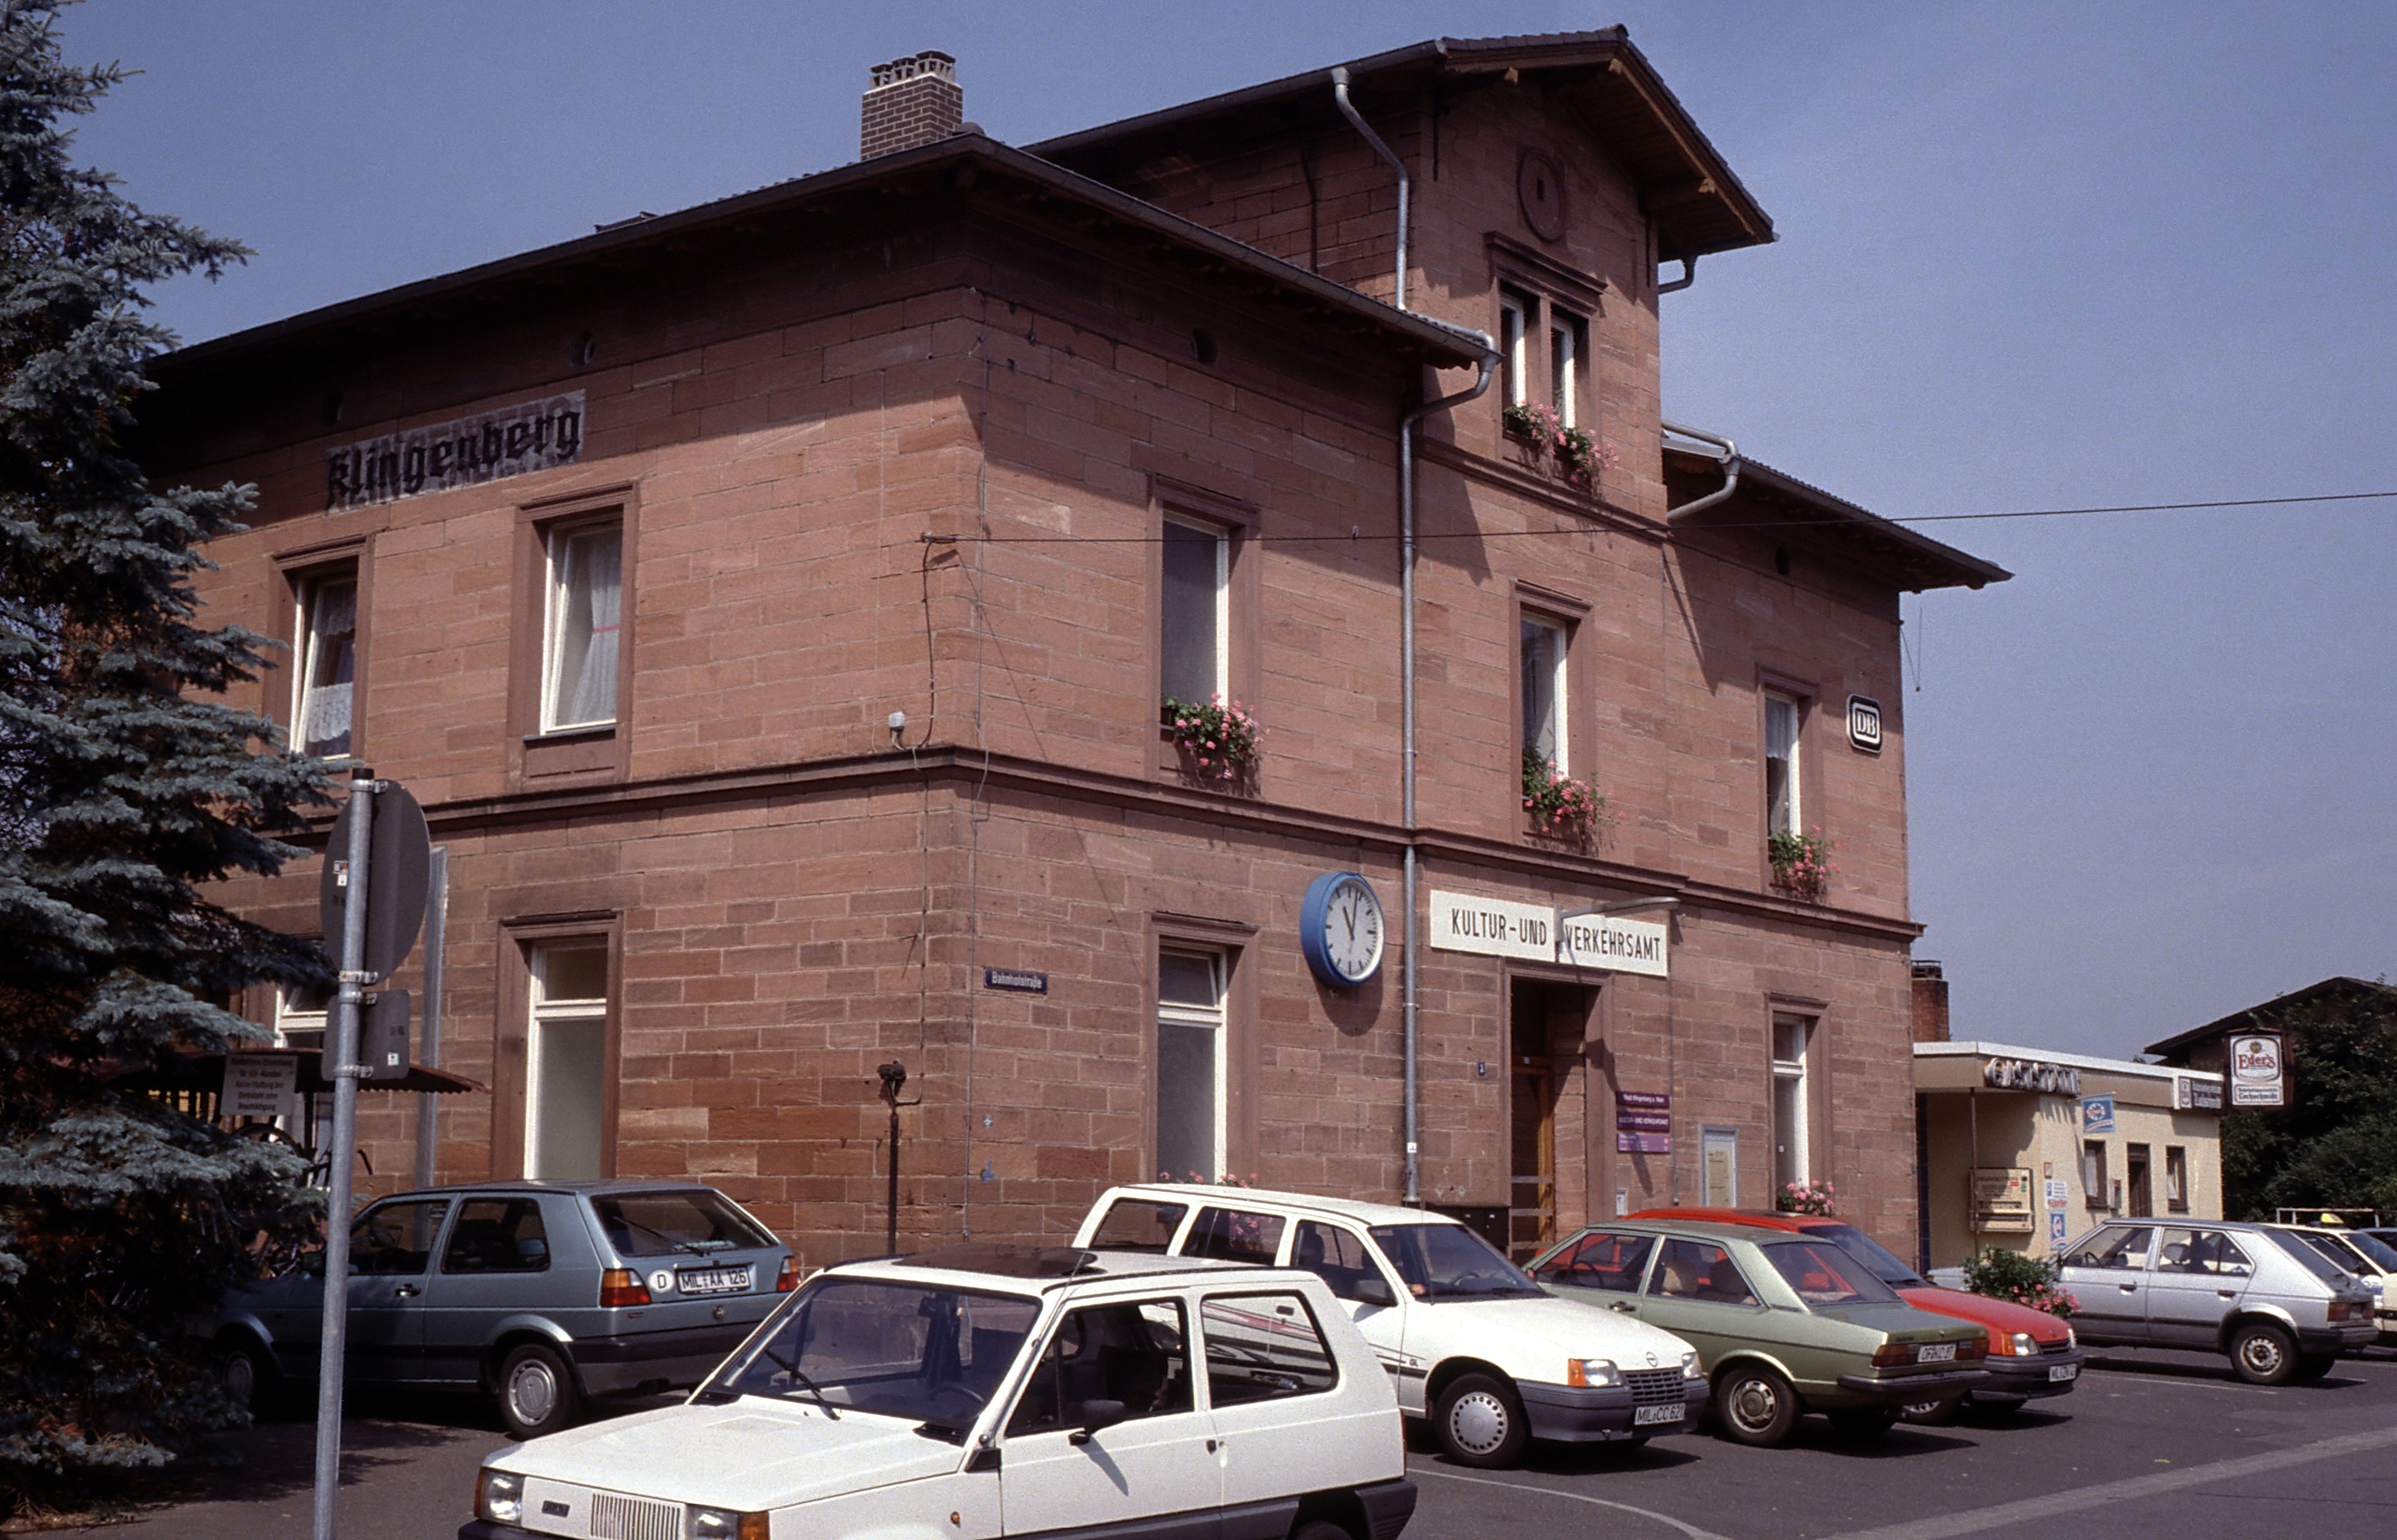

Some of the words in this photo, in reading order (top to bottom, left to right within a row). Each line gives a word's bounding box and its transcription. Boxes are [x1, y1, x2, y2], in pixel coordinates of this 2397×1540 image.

[327, 410, 580, 502] Klingenberg
[1856, 711, 1876, 736] DB
[1564, 925, 1661, 962] VERKEHRSAMT
[991, 971, 1042, 989] Bahnhofstraße
[656, 1274, 667, 1289] D
[727, 1269, 746, 1285] 126
